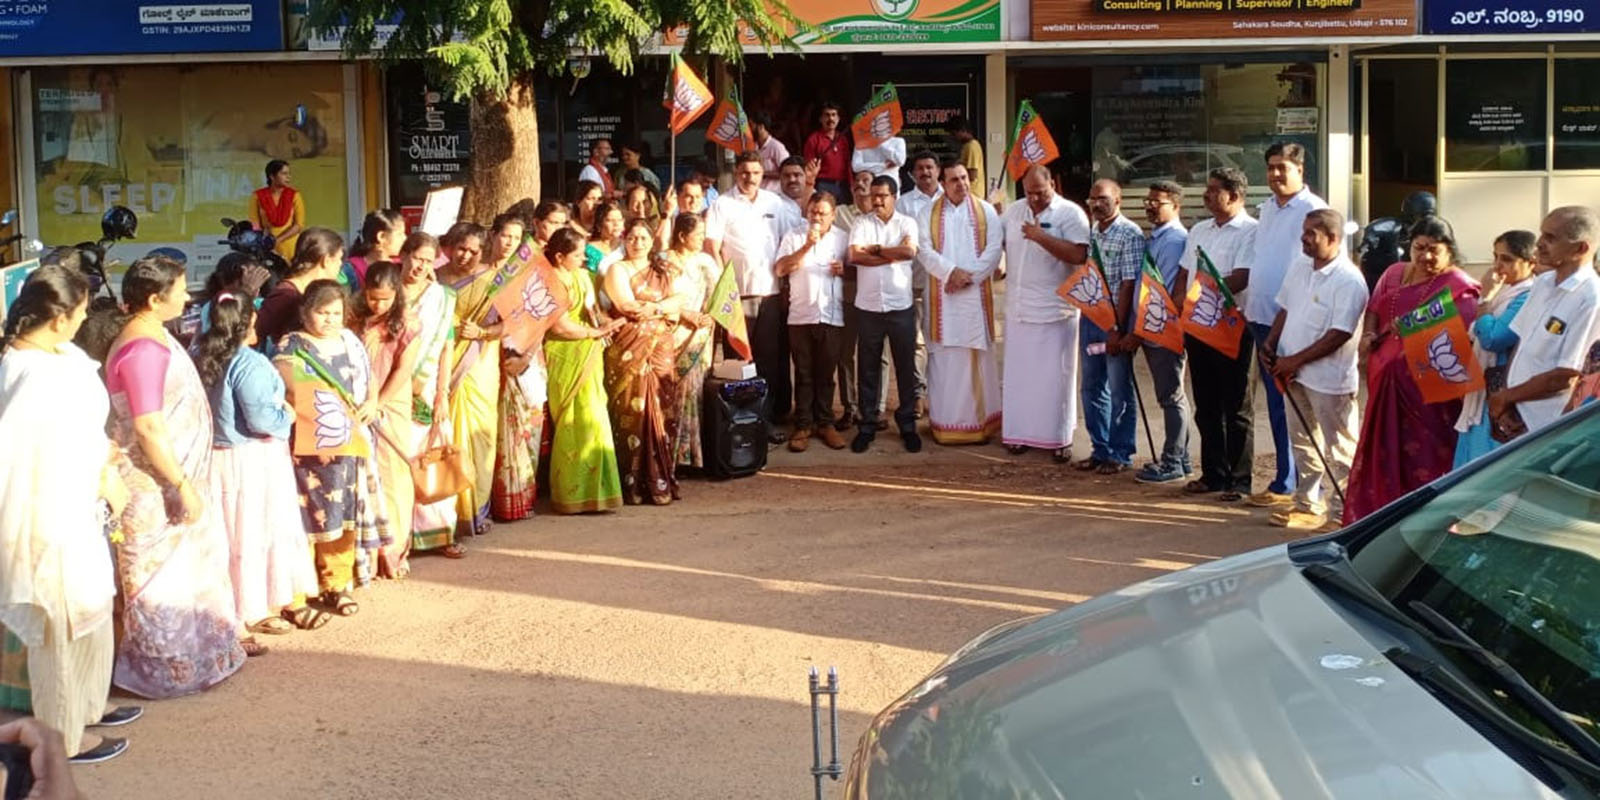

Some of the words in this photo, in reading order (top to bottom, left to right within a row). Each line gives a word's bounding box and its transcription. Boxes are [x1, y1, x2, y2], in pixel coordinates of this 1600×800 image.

[15, 4, 48, 15] FOAM
[1103, 0, 1162, 10] Consulting
[1175, 0, 1222, 10] Planning
[1235, 0, 1293, 8] Supervisor
[1306, 0, 1354, 8] Engineer
[1450, 9, 1490, 25] ಎಲ್.
[1494, 7, 1543, 28] ನಂಬ್ರ.
[1546, 8, 1584, 23] 9190
[1042, 22, 1076, 32] website:
[1077, 22, 1160, 32] kiniconsultancy.com
[1232, 20, 1269, 29] Sahakara
[1270, 20, 1303, 29] Soudha,
[1350, 19, 1373, 28] Udupi
[1395, 18, 1408, 27] 102
[408, 135, 460, 159] SMART
[53, 183, 176, 215] SLEEP
